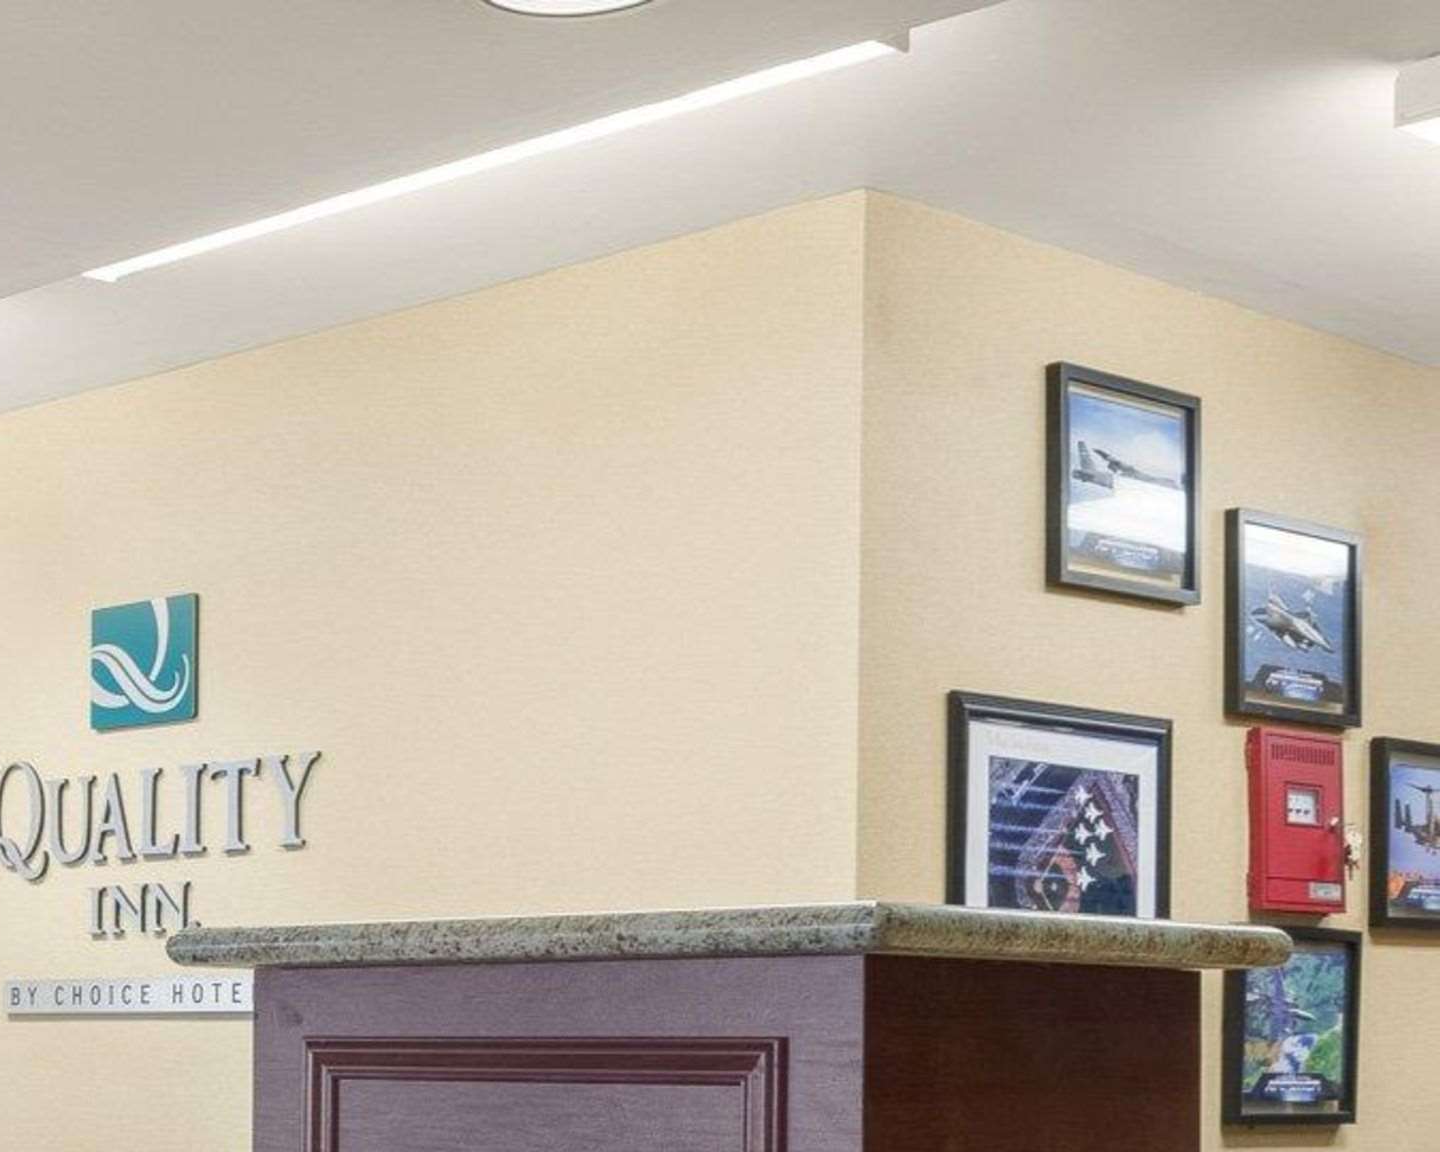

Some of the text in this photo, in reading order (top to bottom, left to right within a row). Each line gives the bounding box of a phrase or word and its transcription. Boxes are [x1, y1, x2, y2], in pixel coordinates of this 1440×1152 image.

[87, 880, 192, 939] INN
[10, 986, 38, 1006] BY
[54, 984, 151, 1006] CHOICE
